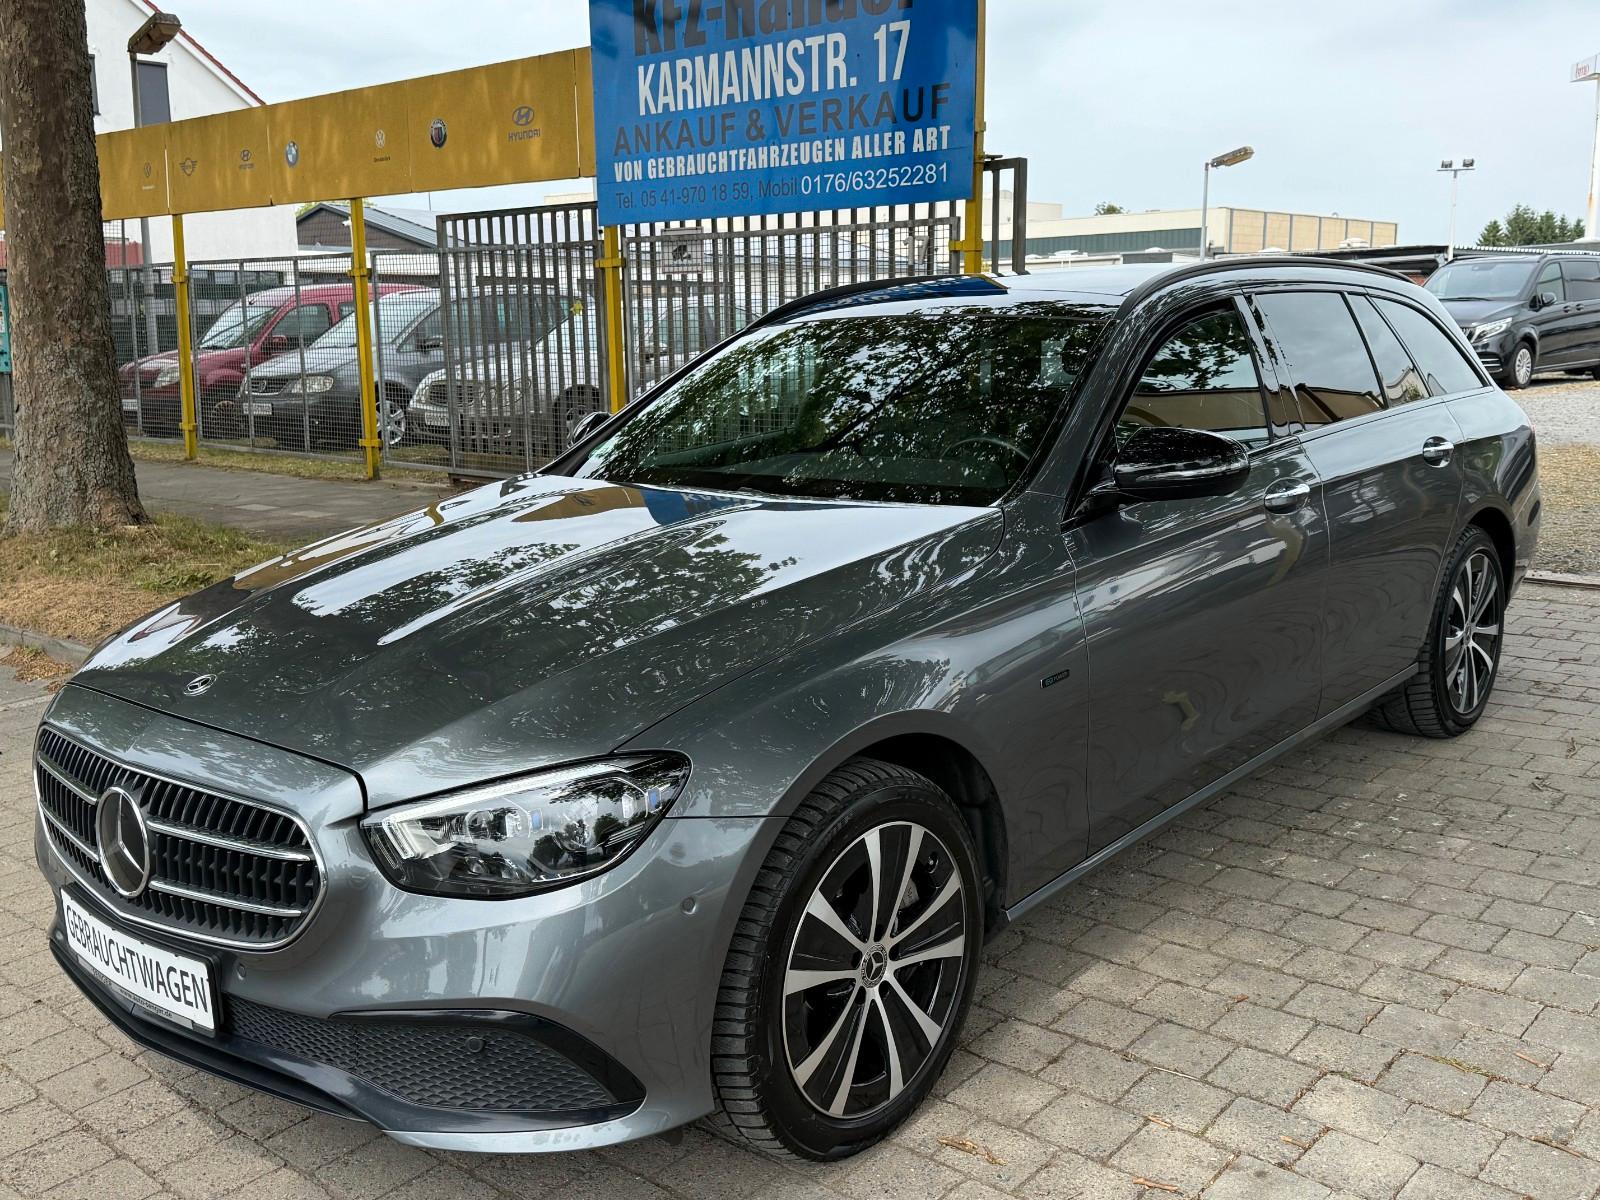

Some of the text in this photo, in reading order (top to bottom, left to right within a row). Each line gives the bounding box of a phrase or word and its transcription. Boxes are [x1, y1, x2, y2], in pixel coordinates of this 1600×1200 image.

[637, 20, 911, 116] KARMANNSTR. 17
[613, 83, 951, 157] ANKAUF & VERKAUF
[614, 125, 951, 183] VON GEBRAUCHTFAHRZEUGEN ALLER ART
[615, 192, 637, 209] Tel.
[758, 176, 798, 198] Mobil
[801, 162, 948, 195] 0176/63252281
[66, 904, 209, 1013] GEBRAUCHTWAGEN
